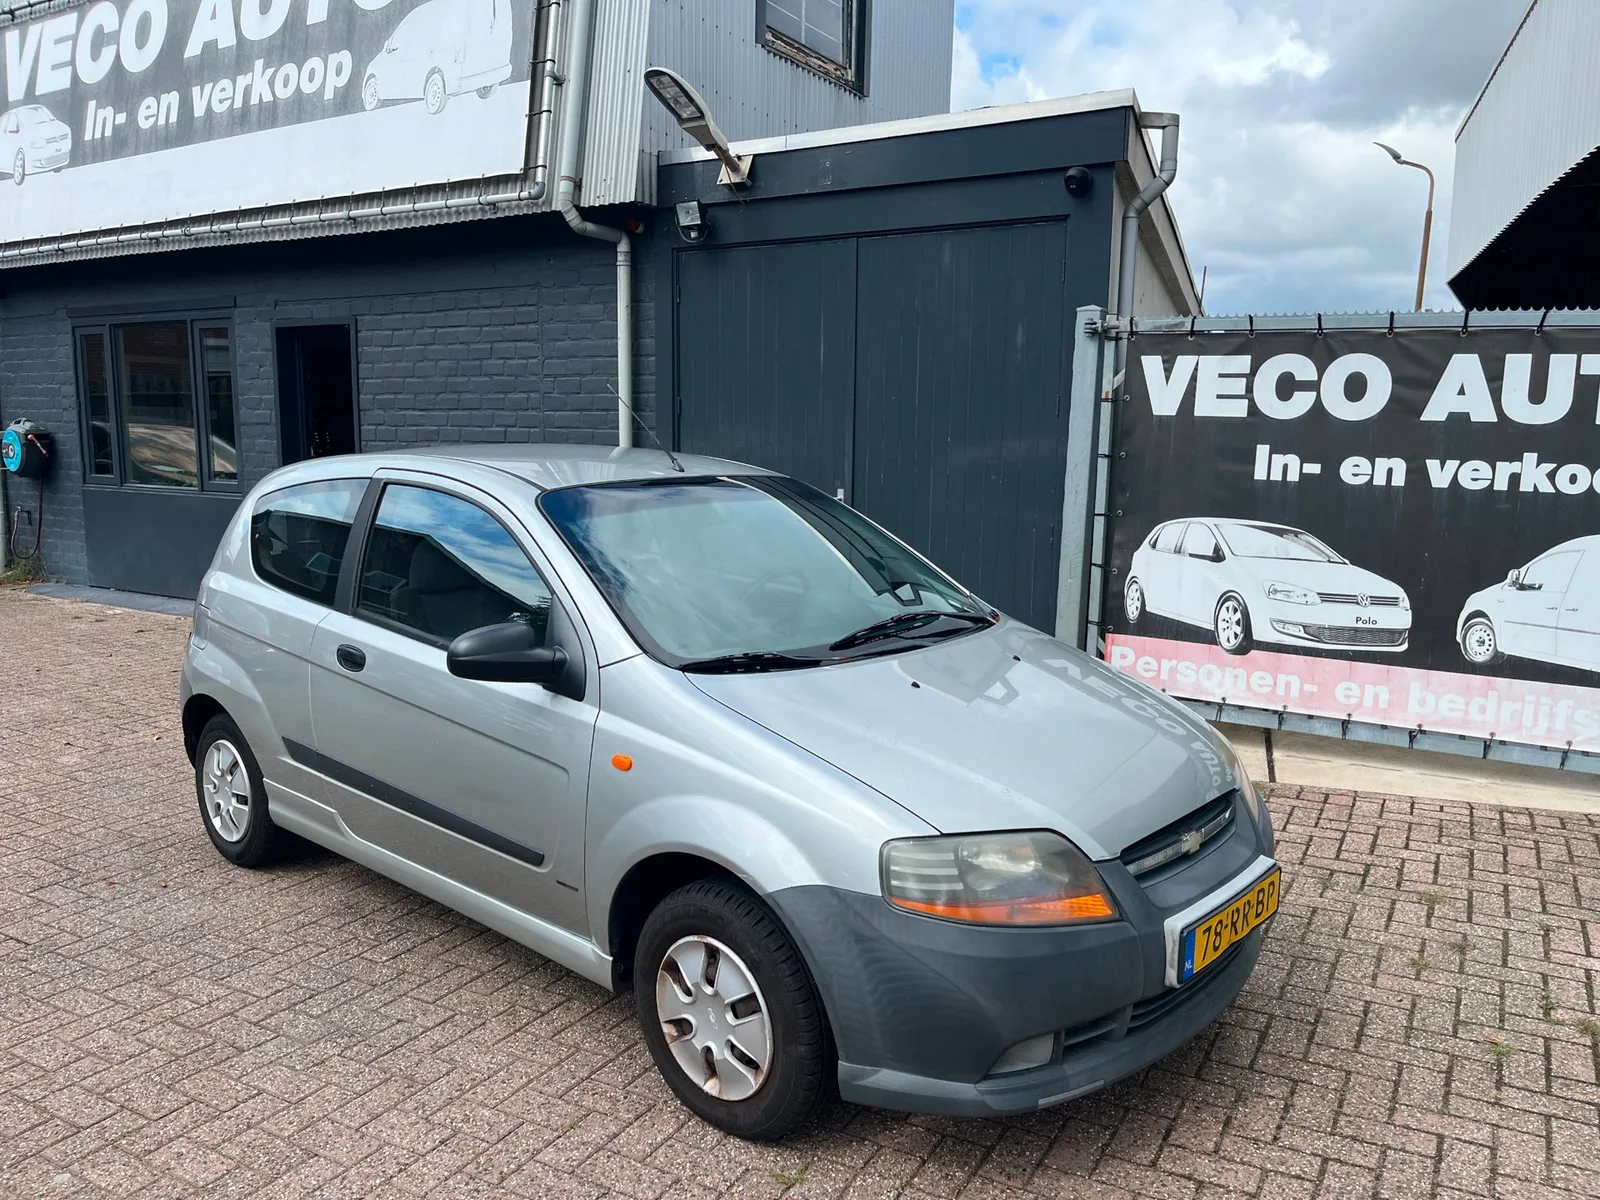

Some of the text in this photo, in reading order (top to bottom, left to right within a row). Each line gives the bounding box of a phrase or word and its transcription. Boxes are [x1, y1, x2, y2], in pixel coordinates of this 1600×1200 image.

[5, 0, 393, 102] VECO AU
[84, 49, 353, 141] In- en verkoop
[1140, 353, 1393, 421] VECO
[1253, 444, 1600, 495] In- en verko
[1355, 616, 1378, 625] Polo
[1110, 645, 1318, 698] Personen-
[1335, 680, 1390, 709] en
[1201, 880, 1275, 963] 78-RR-BP
